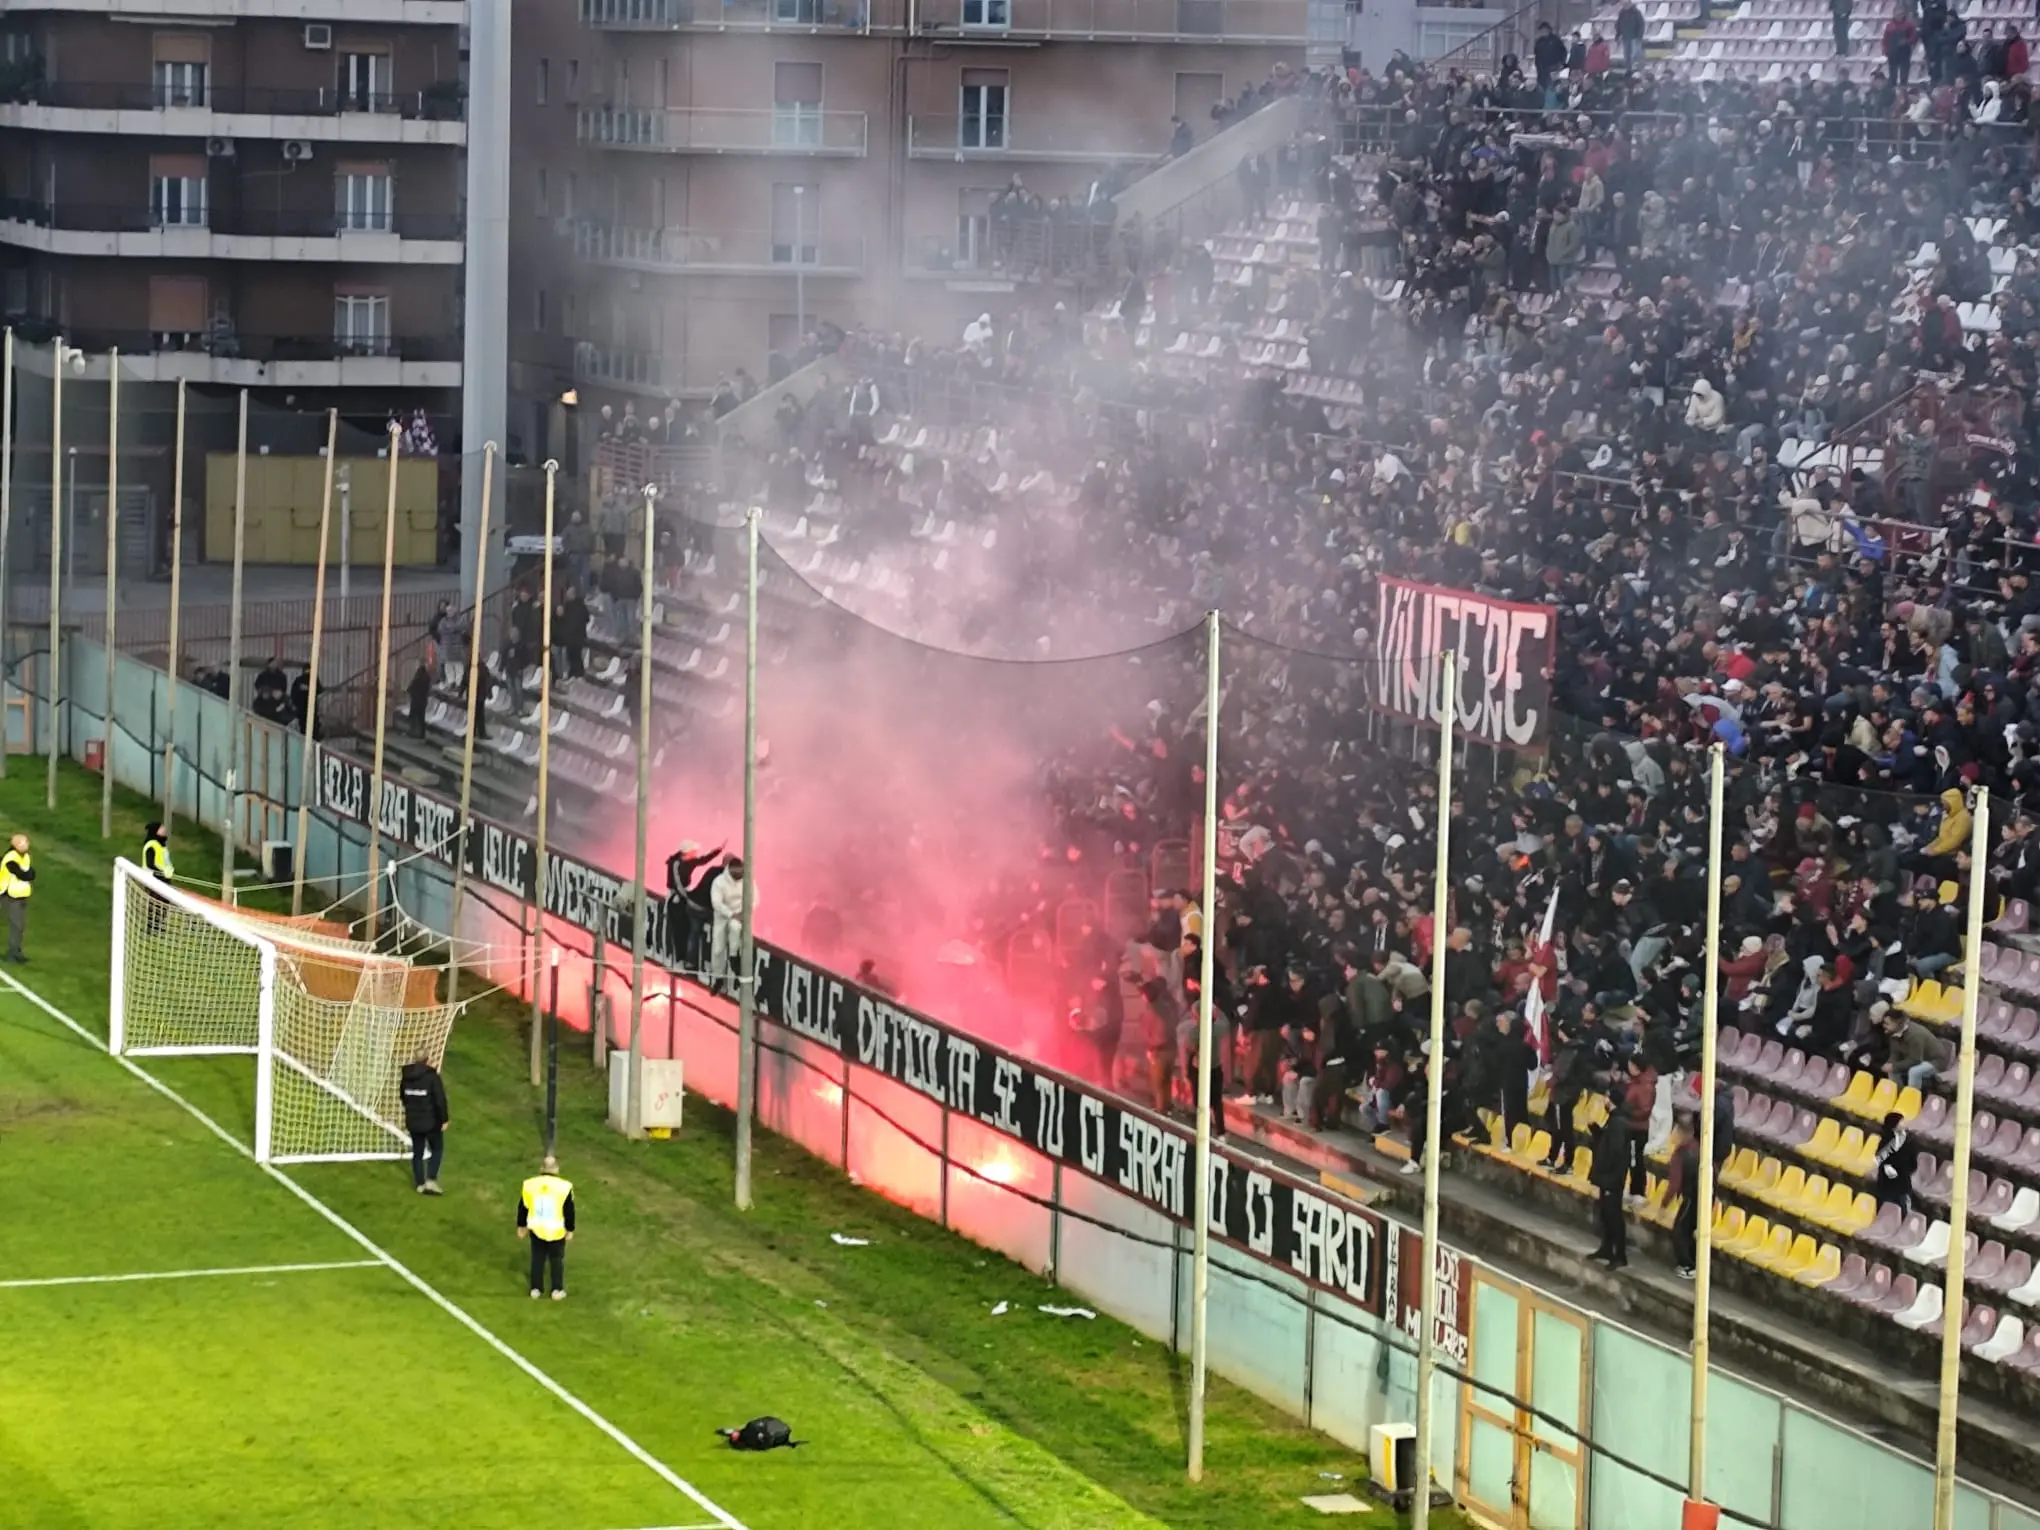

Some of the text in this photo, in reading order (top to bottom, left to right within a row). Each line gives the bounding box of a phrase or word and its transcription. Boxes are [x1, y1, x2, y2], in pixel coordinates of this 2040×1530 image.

[483, 824, 527, 898] NELLE
[783, 960, 843, 1051] NELLE
[993, 1056, 1022, 1137] SE
[1034, 1074, 1065, 1157] TU
